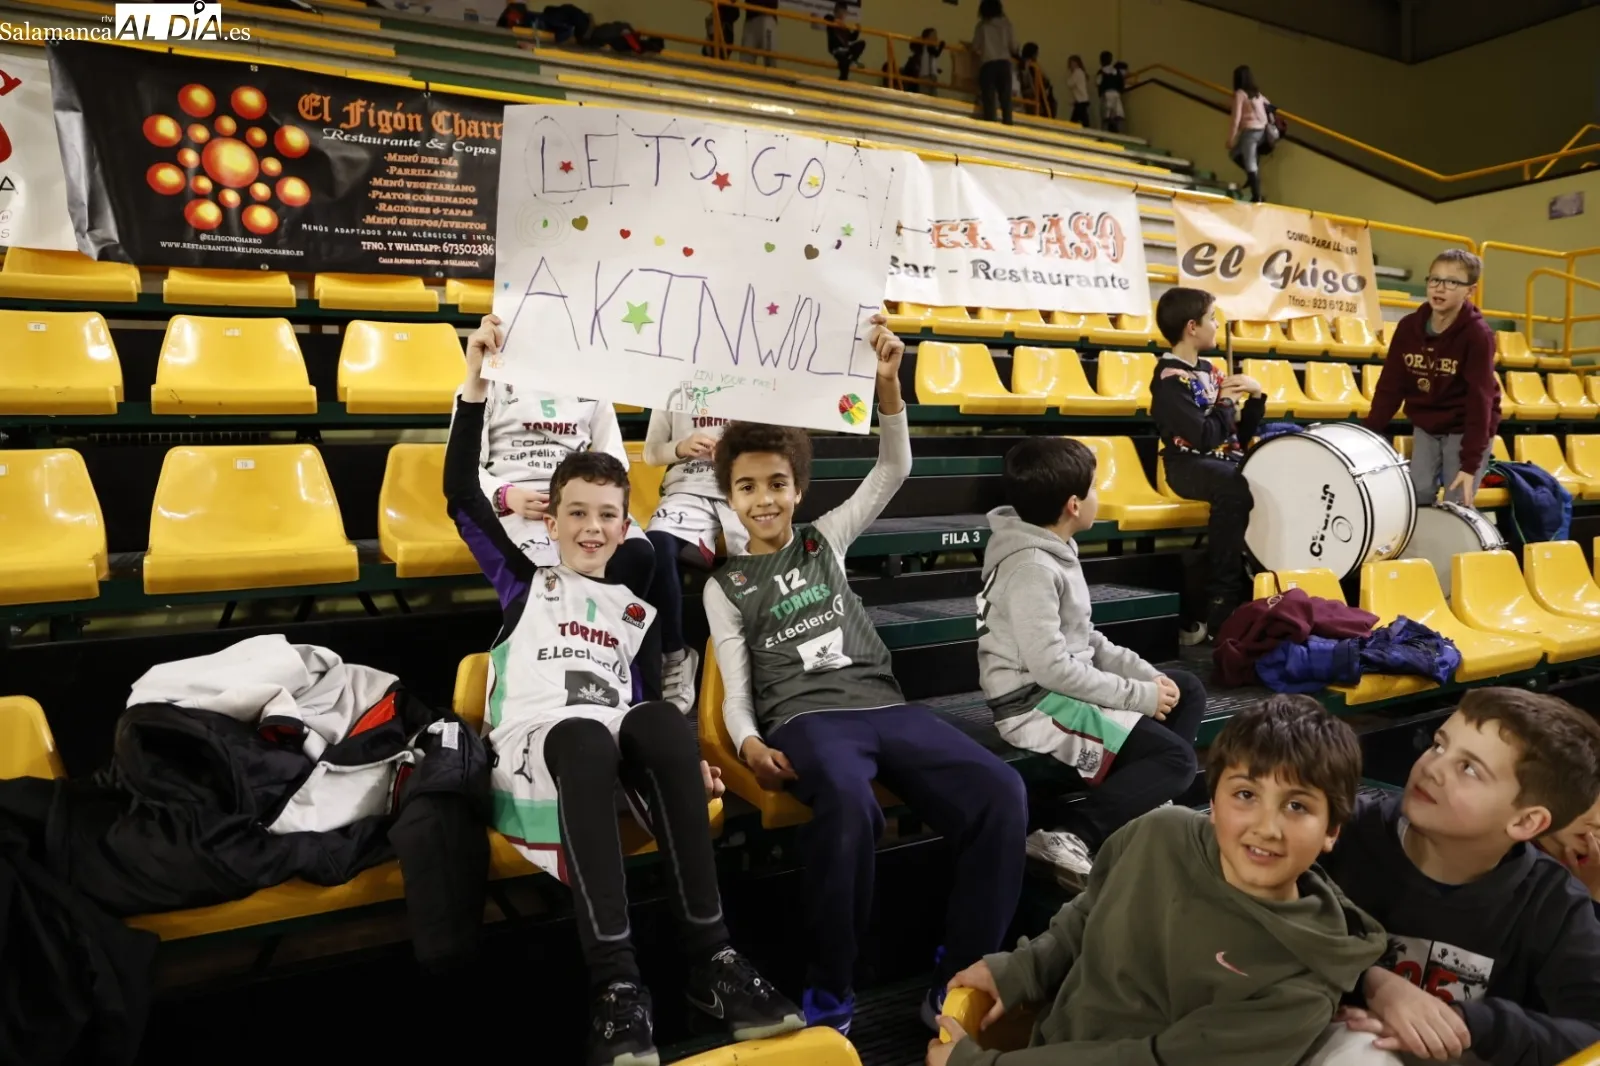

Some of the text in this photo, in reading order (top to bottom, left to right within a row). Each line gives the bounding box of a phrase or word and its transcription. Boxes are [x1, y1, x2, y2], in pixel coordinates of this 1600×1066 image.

[298, 92, 332, 122] El
[340, 99, 424, 135] Figón
[322, 128, 497, 156] Restaurante & Copas
[442, 241, 495, 256] 673502386
[927, 211, 1128, 264] EL PASO
[1311, 236, 1332, 250] PARA
[1181, 242, 1246, 279] El
[970, 258, 1131, 290] Restaurante
[540, 399, 557, 419] 5
[523, 421, 578, 436] TORMES
[527, 460, 540, 468] de
[543, 461, 553, 469] la
[530, 448, 557, 459] Félix
[941, 531, 981, 545] FILA 3
[773, 567, 808, 596] 12
[769, 583, 832, 620] TORMES
